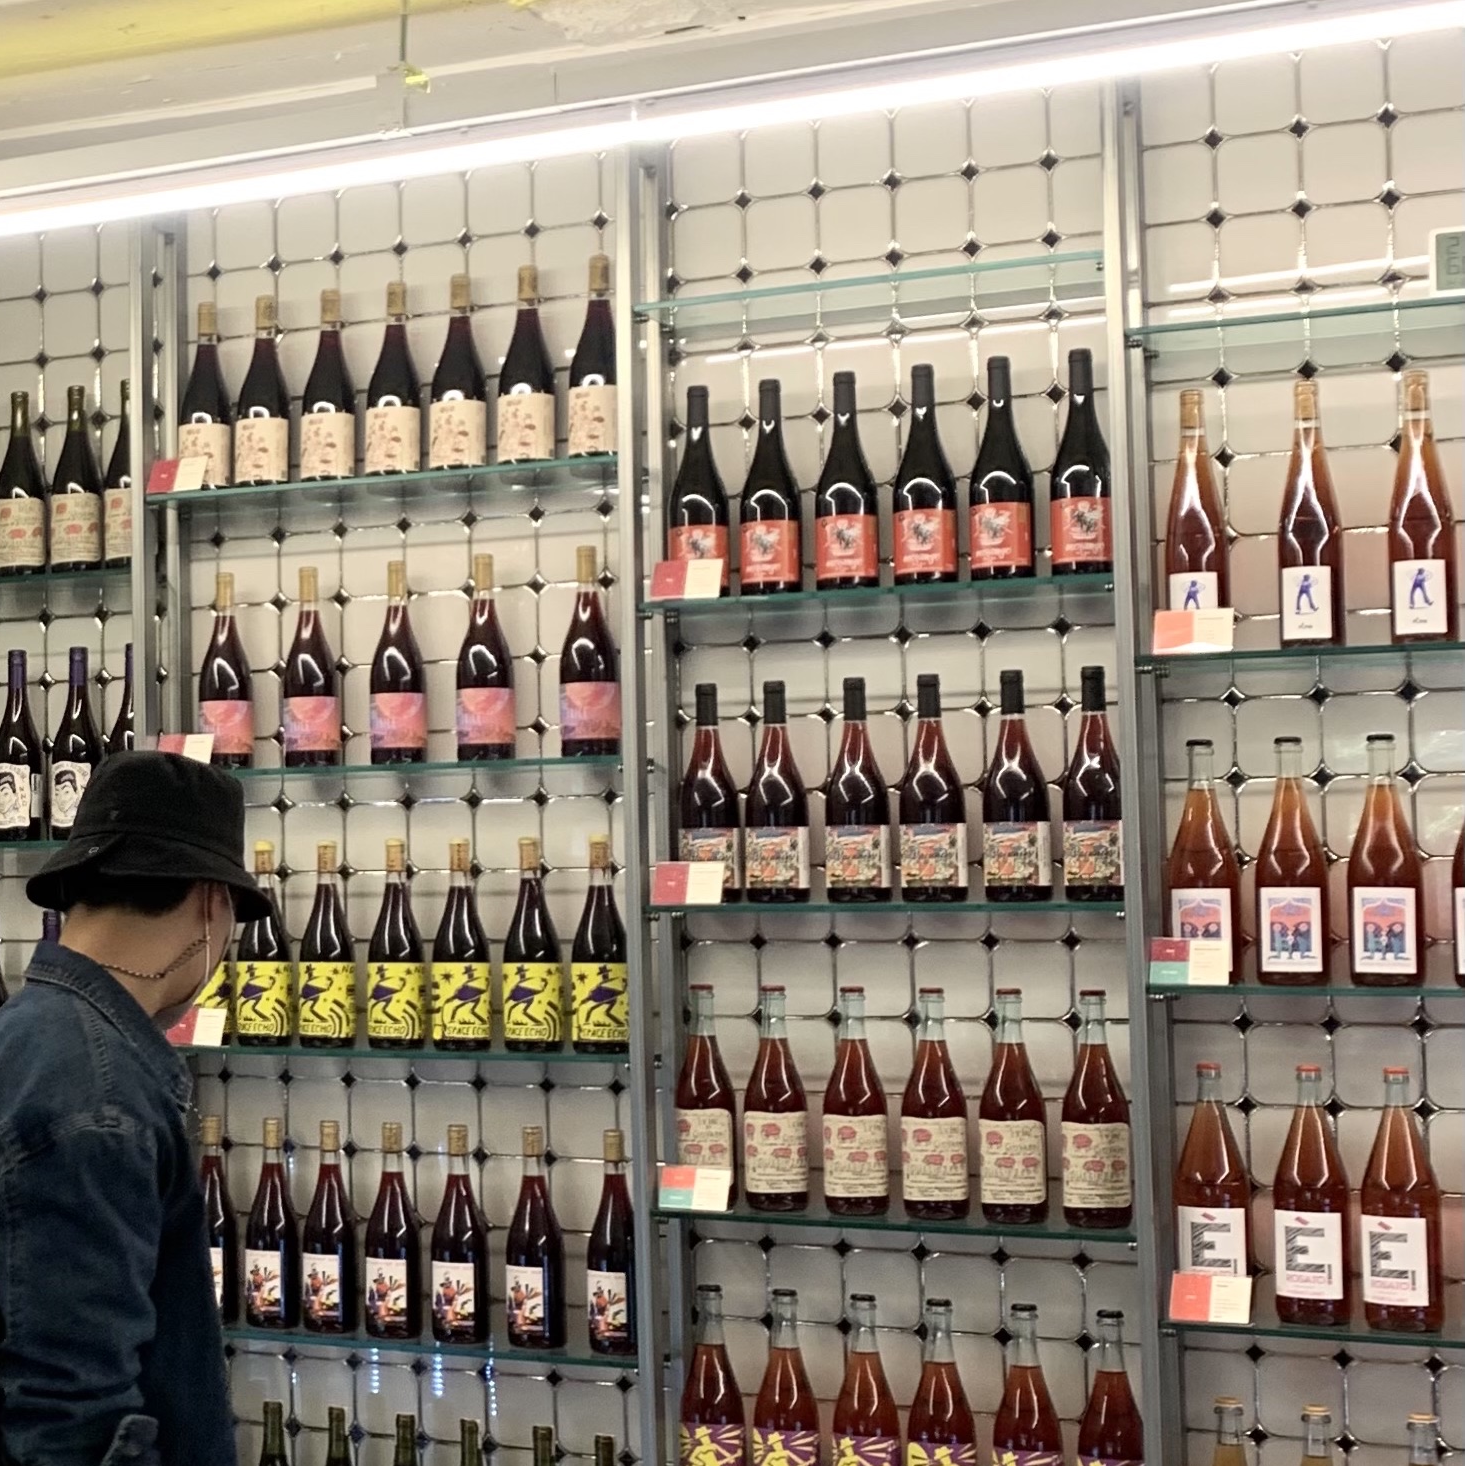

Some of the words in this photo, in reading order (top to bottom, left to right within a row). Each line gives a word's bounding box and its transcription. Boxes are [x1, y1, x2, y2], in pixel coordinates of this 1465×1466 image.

[253, 1023, 275, 1032] ECHO
[311, 1023, 333, 1033] ECHO
[383, 1024, 407, 1034] ECHO
[447, 1026, 470, 1036] SPACE
[524, 1027, 548, 1037] ECHO
[1285, 1226, 1326, 1274] E
[1369, 1231, 1410, 1280] E
